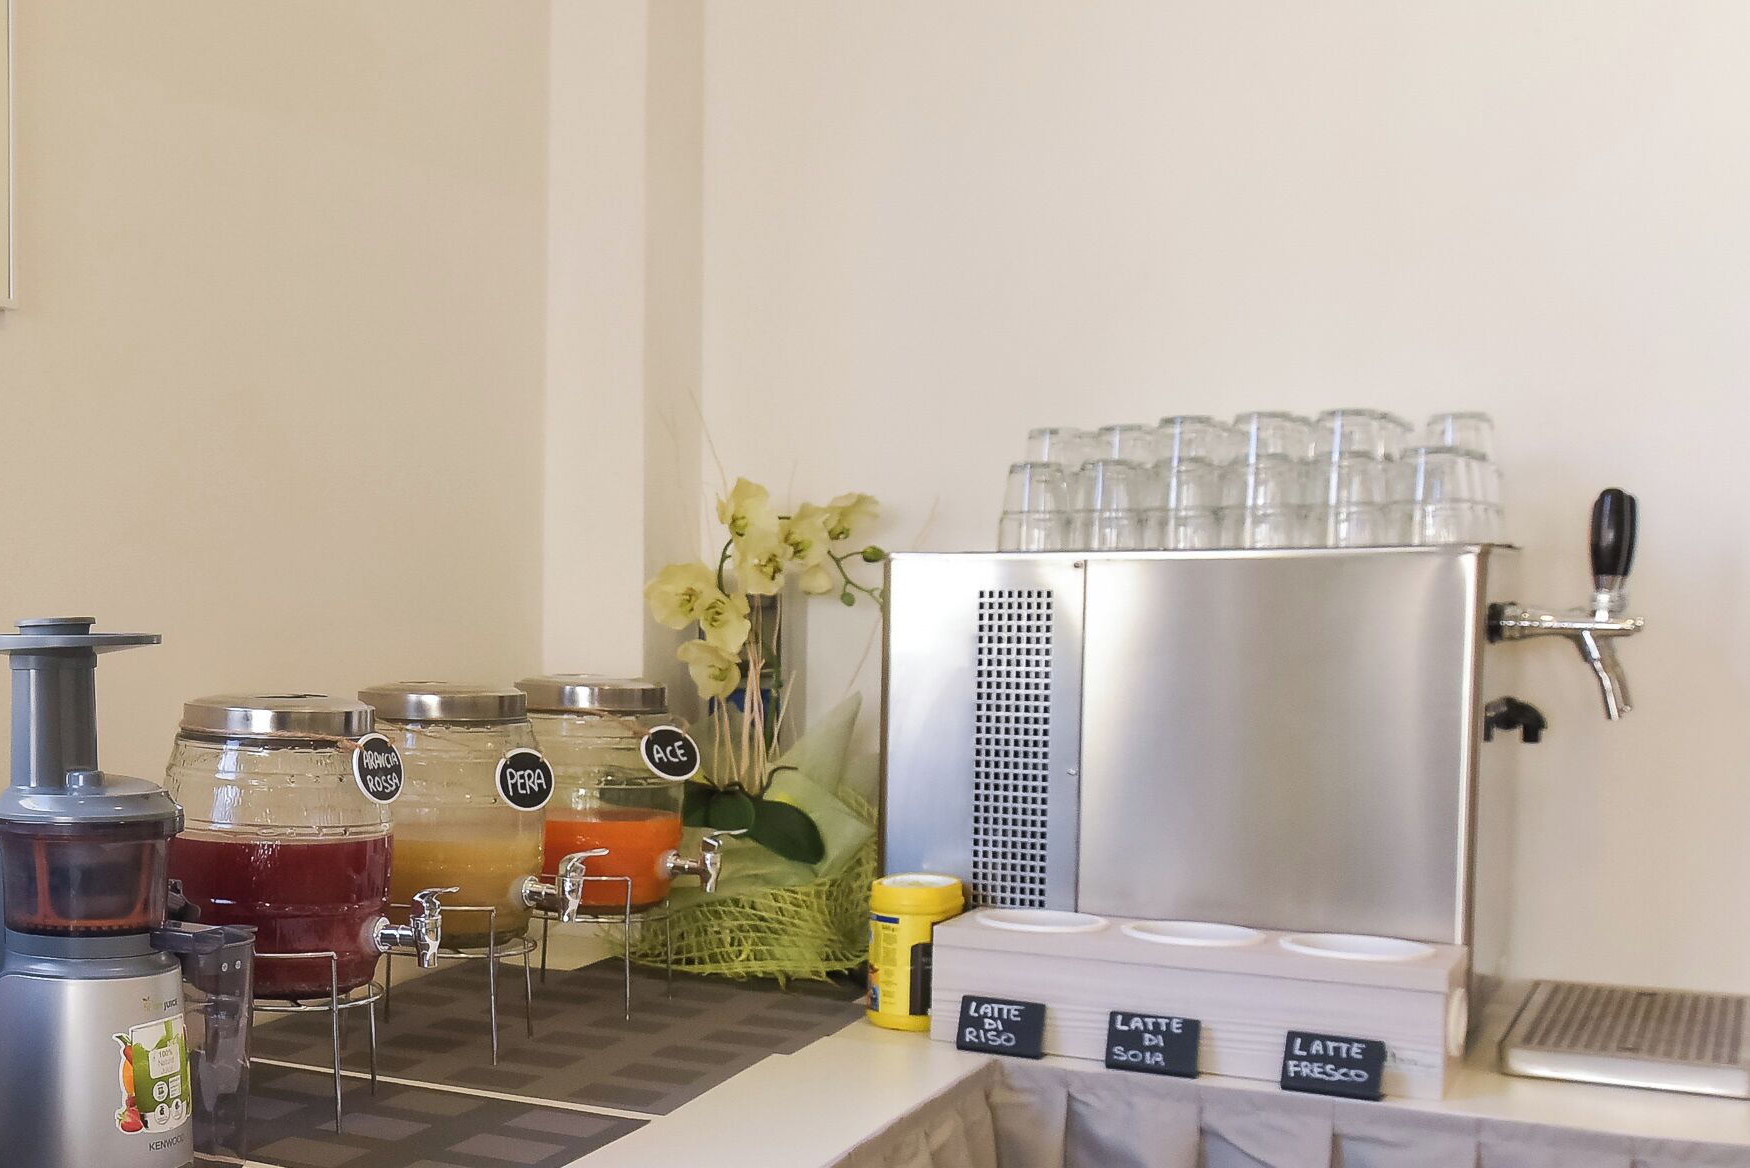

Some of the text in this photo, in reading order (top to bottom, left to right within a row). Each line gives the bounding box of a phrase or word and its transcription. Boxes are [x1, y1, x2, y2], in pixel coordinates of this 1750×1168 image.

[362, 749, 399, 769] ARANCIA
[366, 773, 400, 793] ROSSA
[505, 768, 547, 797] PERA
[969, 1001, 1025, 1021] LATTE
[984, 1017, 1003, 1030] DI
[1115, 1015, 1184, 1034] LATTE
[965, 1027, 1016, 1047] RISO
[1142, 1033, 1165, 1047] DI
[1112, 1046, 1166, 1066] SOIA
[1292, 1037, 1366, 1060] LATTE
[1286, 1060, 1369, 1082] FRESCO
